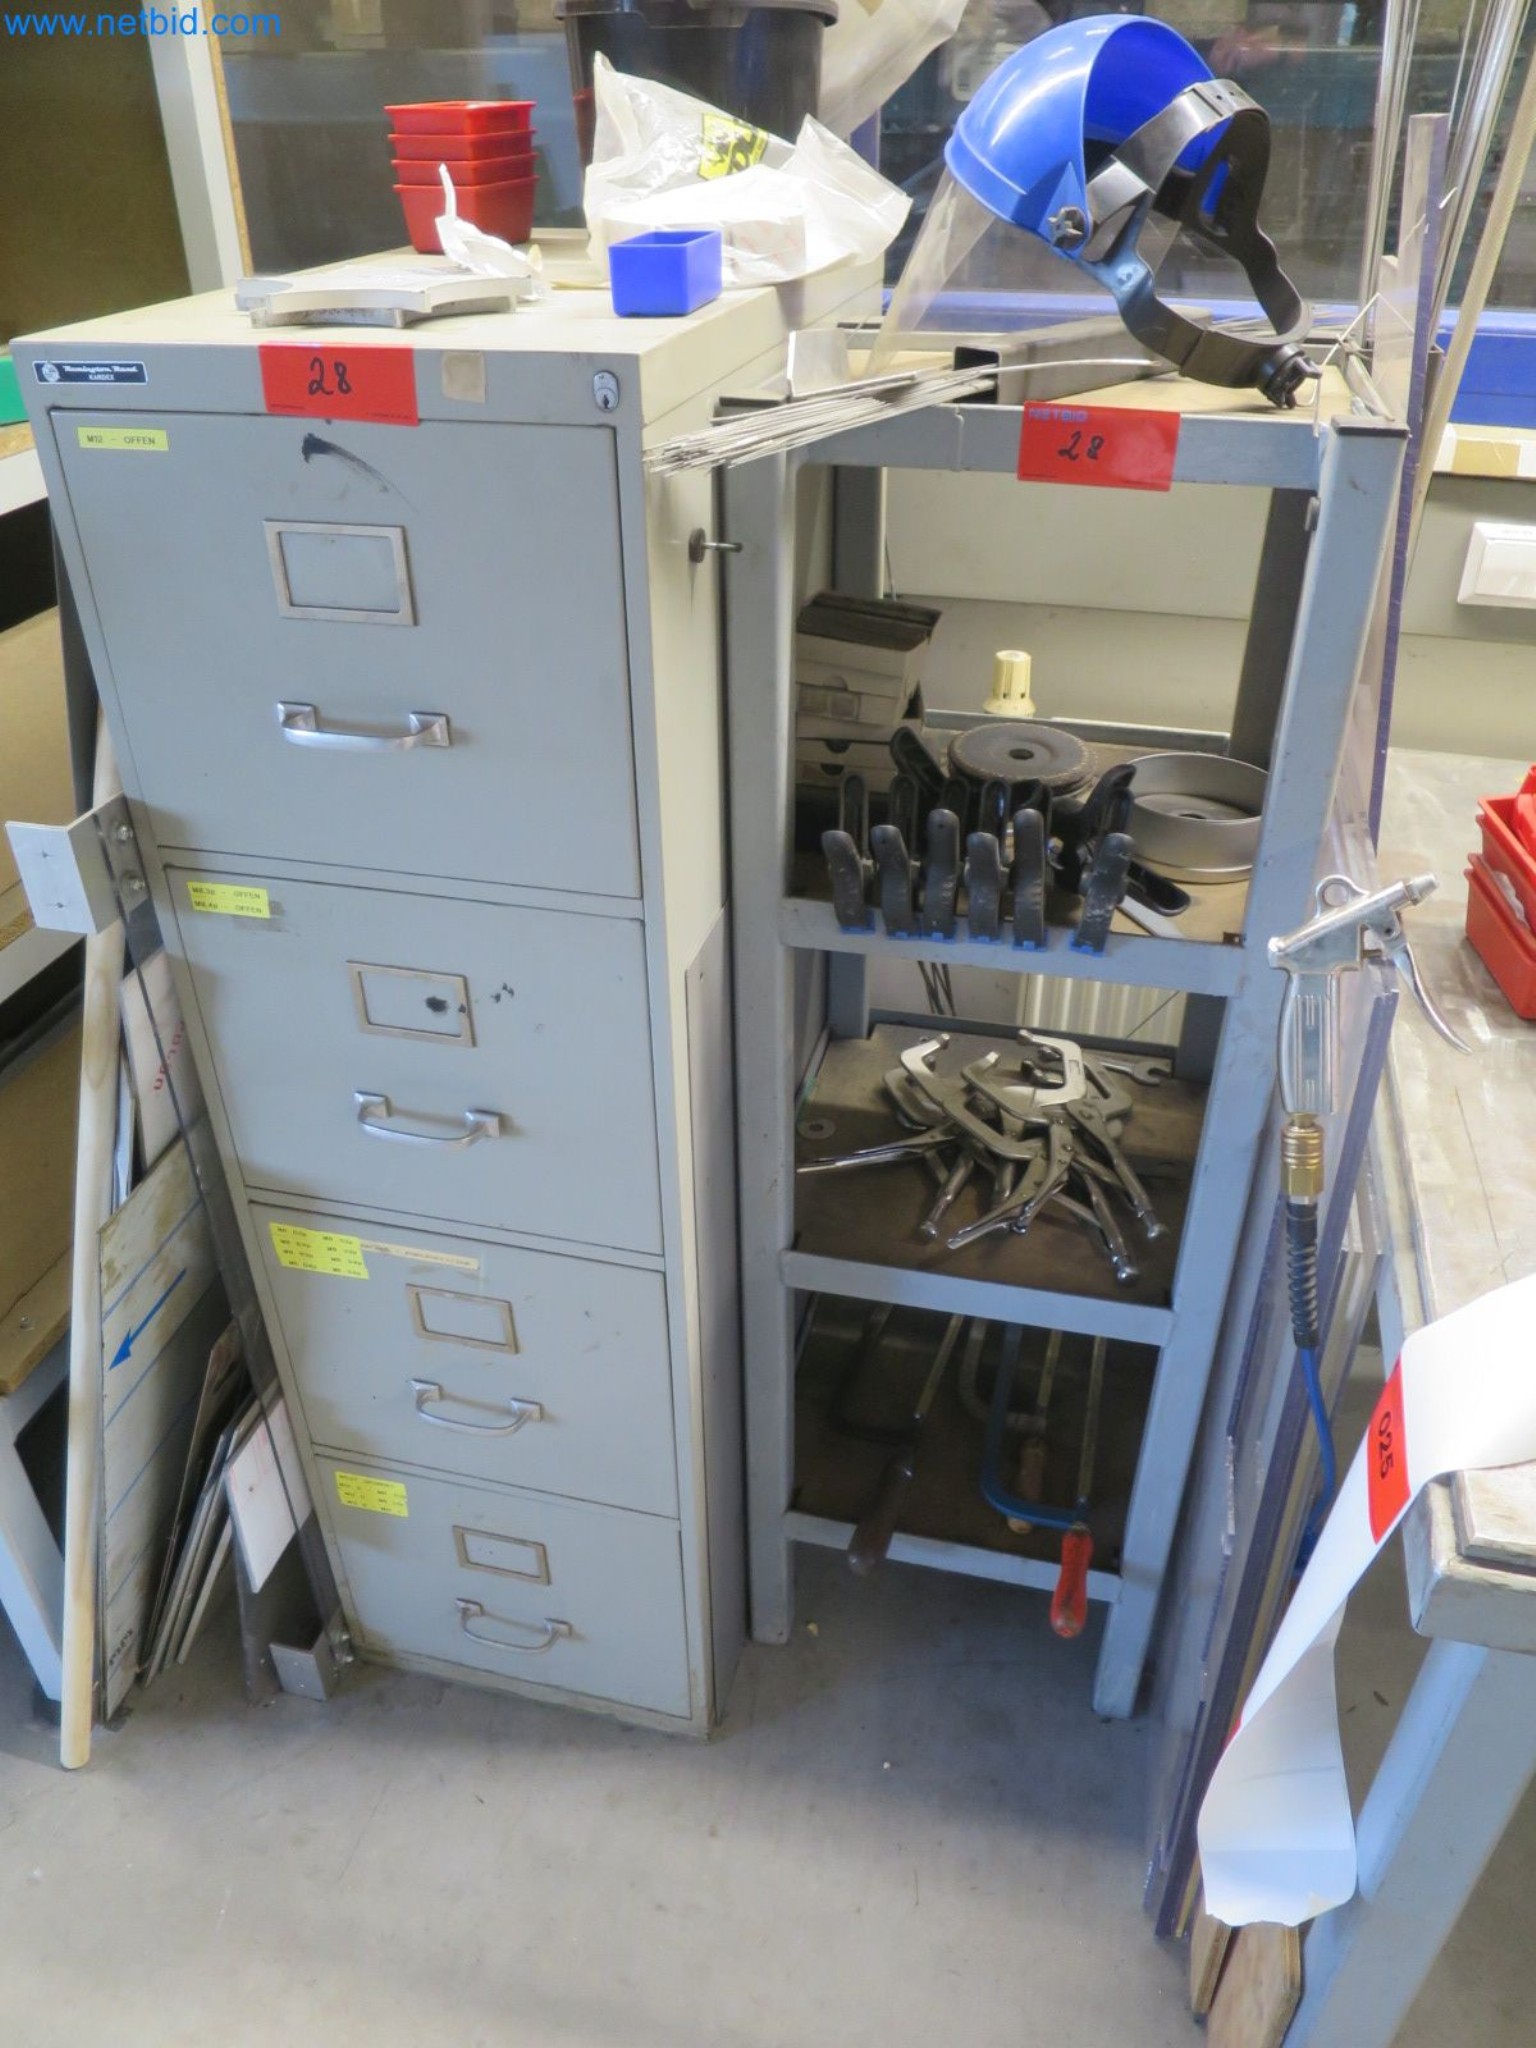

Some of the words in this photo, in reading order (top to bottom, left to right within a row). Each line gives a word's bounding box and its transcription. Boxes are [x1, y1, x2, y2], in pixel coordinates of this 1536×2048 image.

[308, 356, 352, 395] 28
[123, 435, 156, 446] OFFEN
[1057, 430, 1105, 462] 28
[1378, 1411, 1395, 1480] 025
